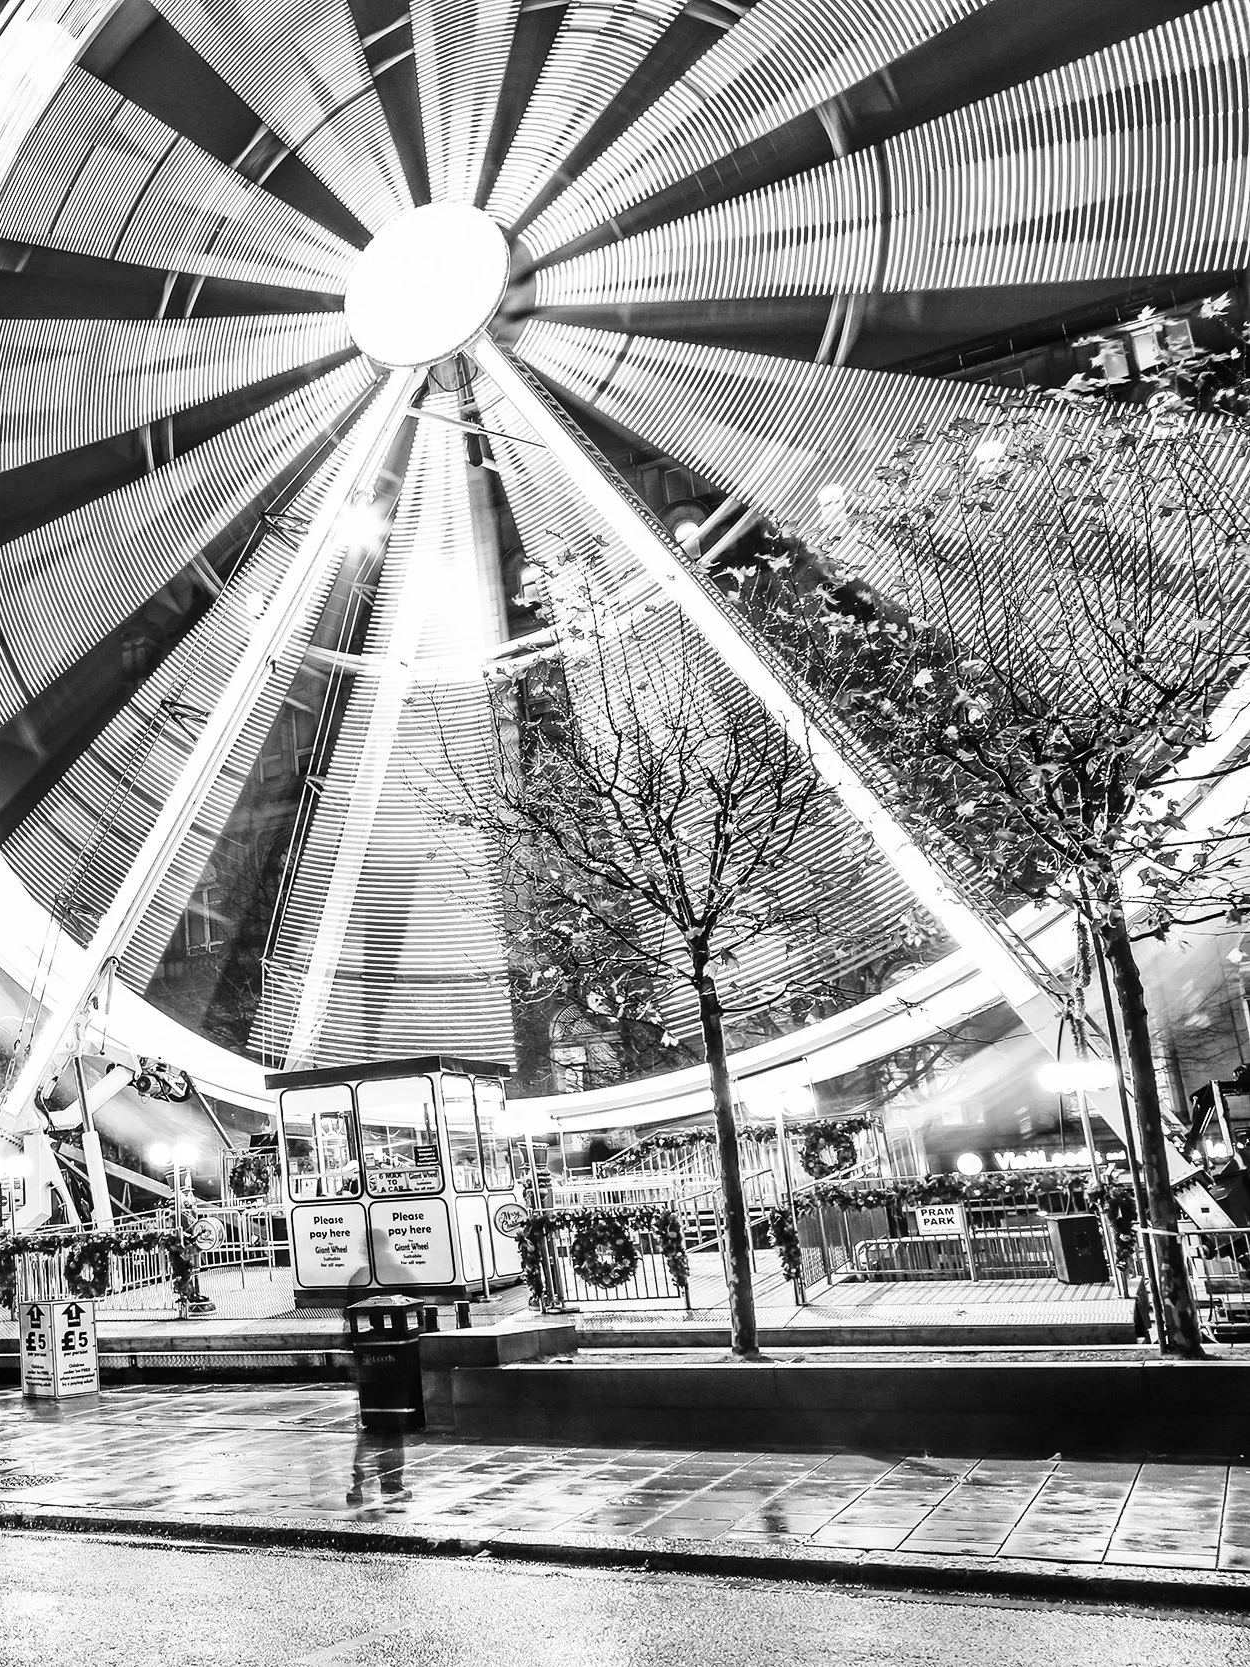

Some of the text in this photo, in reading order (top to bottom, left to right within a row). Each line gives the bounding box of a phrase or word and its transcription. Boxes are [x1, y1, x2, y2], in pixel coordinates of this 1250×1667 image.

[392, 1212, 424, 1221] Please
[920, 1208, 954, 1216] PRAM
[313, 1216, 344, 1225] Please
[923, 1217, 955, 1225] PARK
[310, 1228, 351, 1240] pay here
[388, 1225, 432, 1237] pay here
[315, 1245, 348, 1254] Giant Wheel
[394, 1242, 429, 1251] Giant Wheel
[70, 1305, 76, 1318] 1
